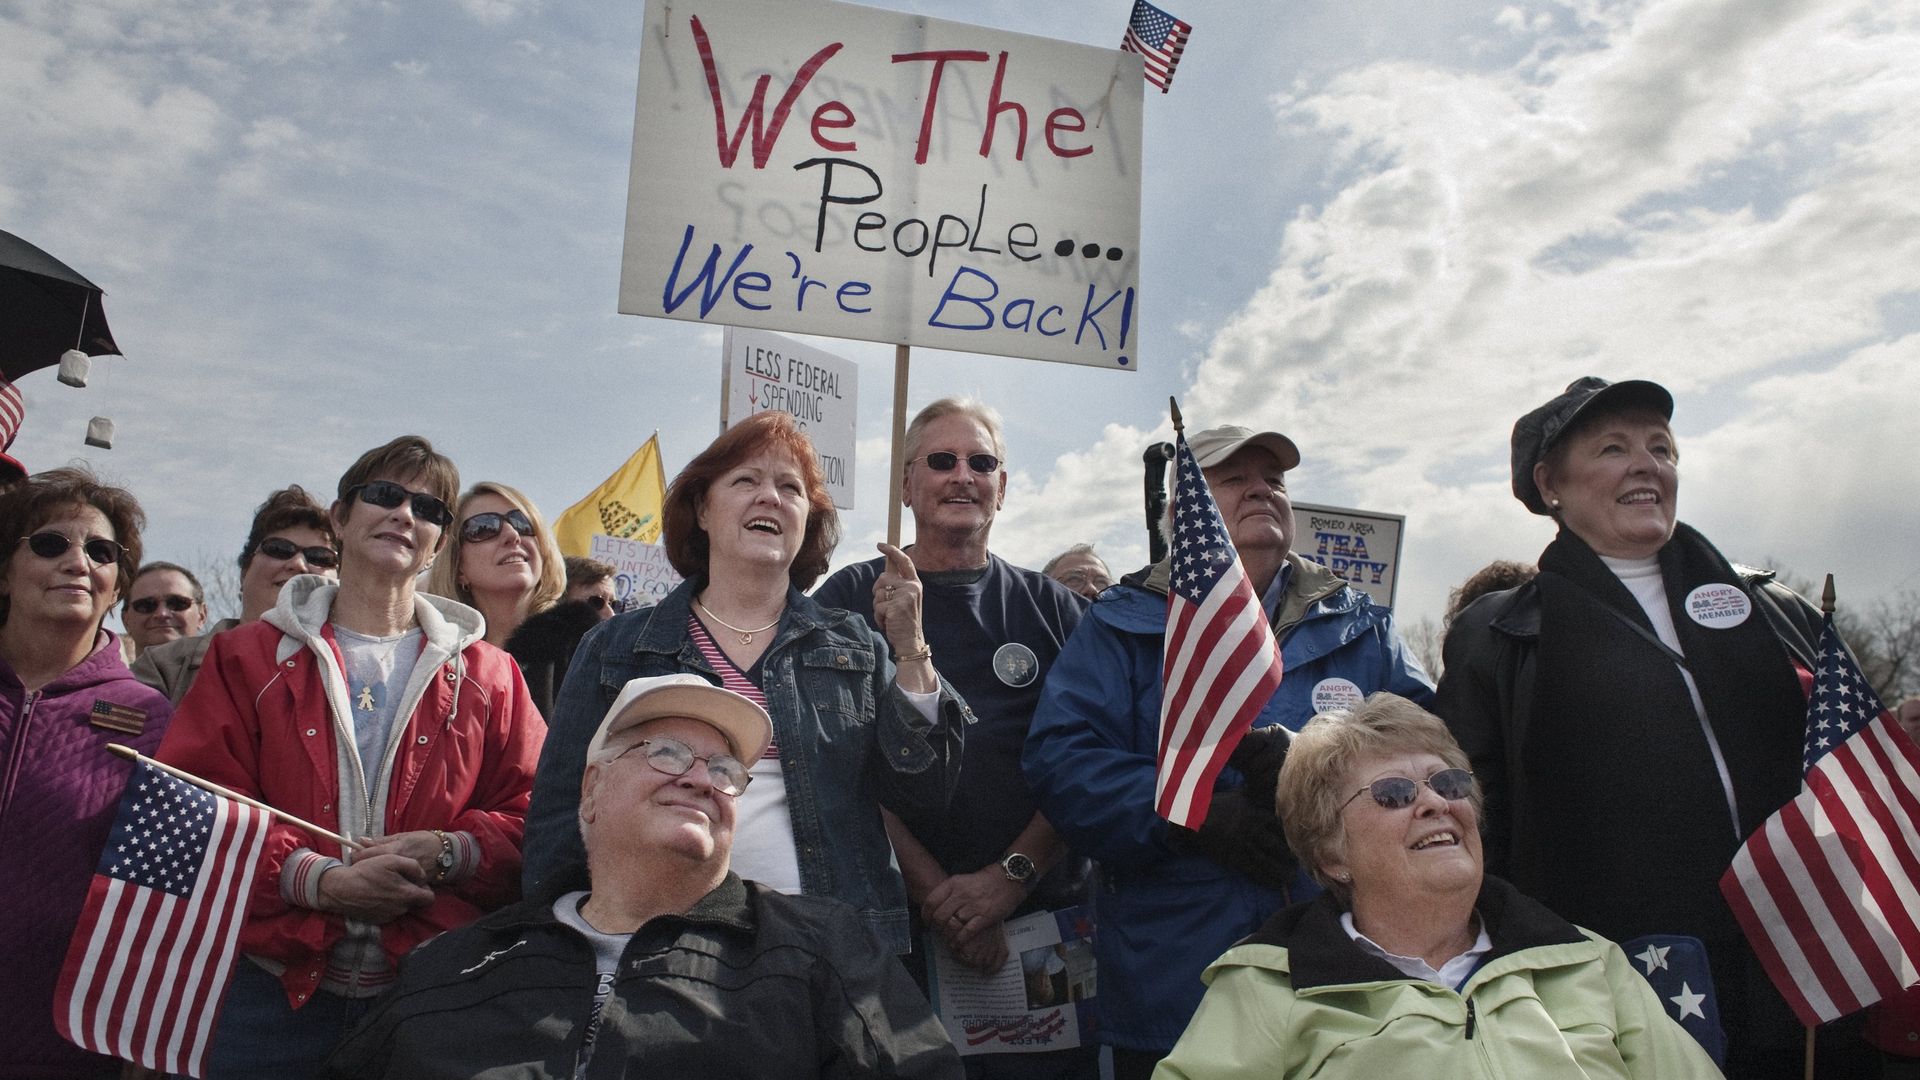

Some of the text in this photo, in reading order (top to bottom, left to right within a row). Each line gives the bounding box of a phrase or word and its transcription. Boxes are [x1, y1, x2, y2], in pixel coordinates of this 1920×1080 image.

[690, 14, 1094, 169] We The
[663, 224, 872, 320] We're
[745, 345, 842, 400] LESS FEDERAL
[761, 383, 823, 423] SPENDING
[1310, 517, 1376, 536] ROMEO AREA
[593, 536, 636, 558] LETS
[641, 544, 667, 563] TA
[1314, 532, 1370, 559] TEA
[1694, 588, 1733, 599] ANGRY
[1698, 608, 1746, 620] MEMBER
